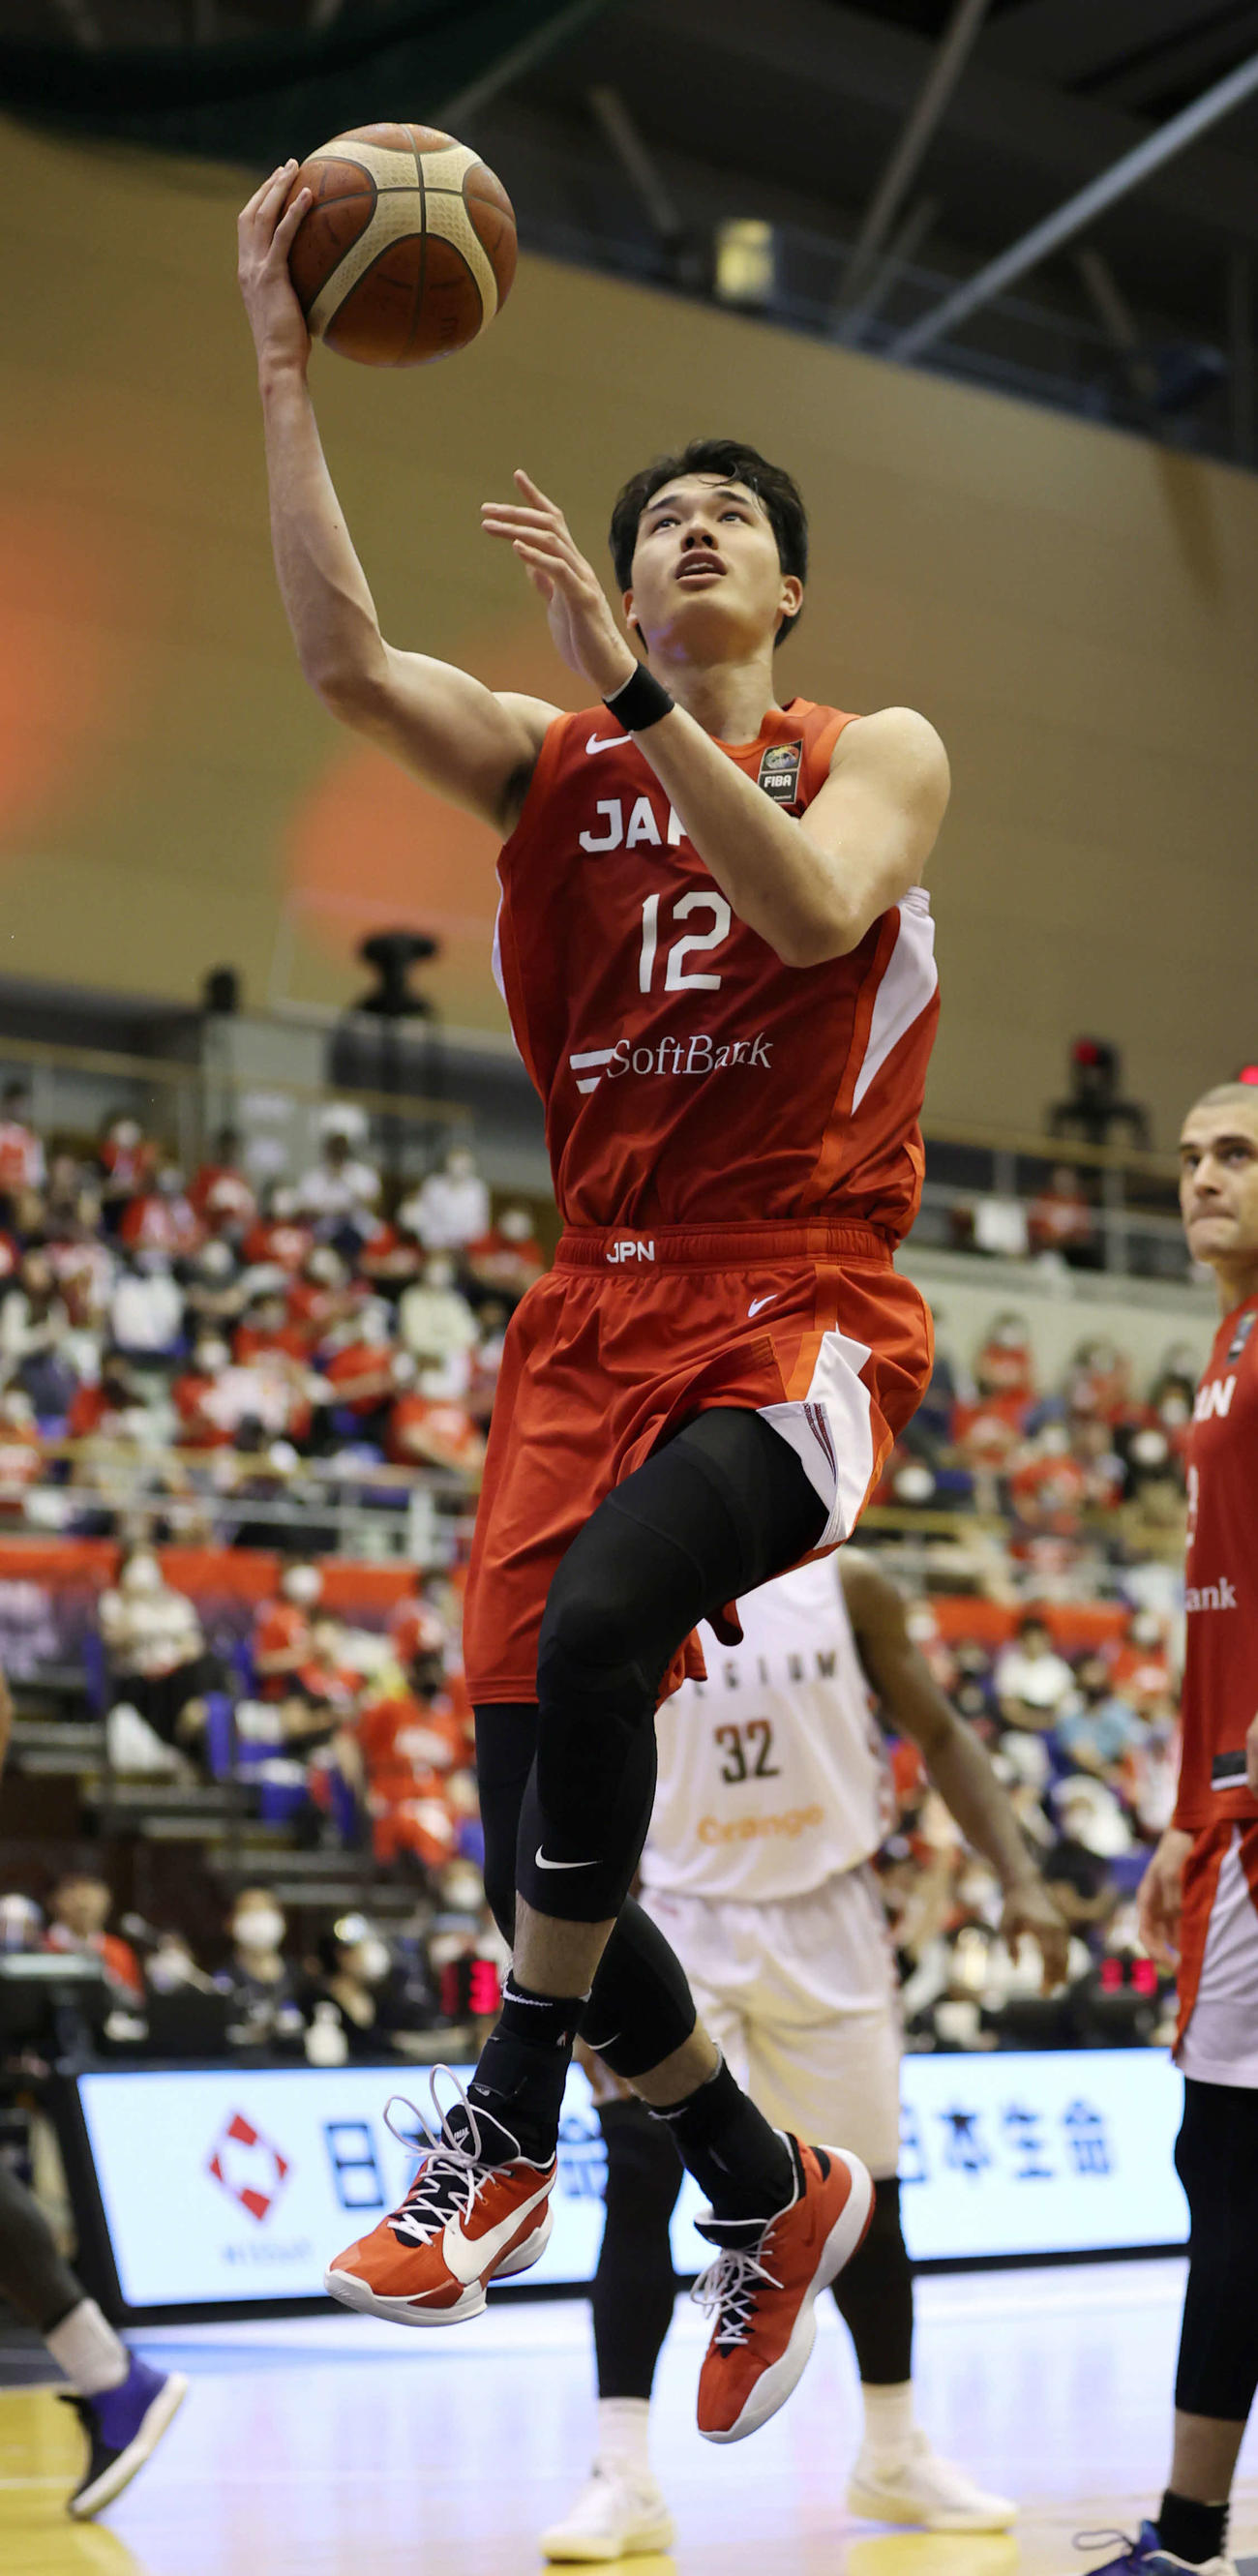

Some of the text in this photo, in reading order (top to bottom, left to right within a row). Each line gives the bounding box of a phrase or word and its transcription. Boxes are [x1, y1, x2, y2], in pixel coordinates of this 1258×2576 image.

[764, 774, 792, 788] FIBA
[640, 891, 731, 993] 12
[607, 1241, 655, 1263] JPN
[713, 1720, 780, 1784] 32
